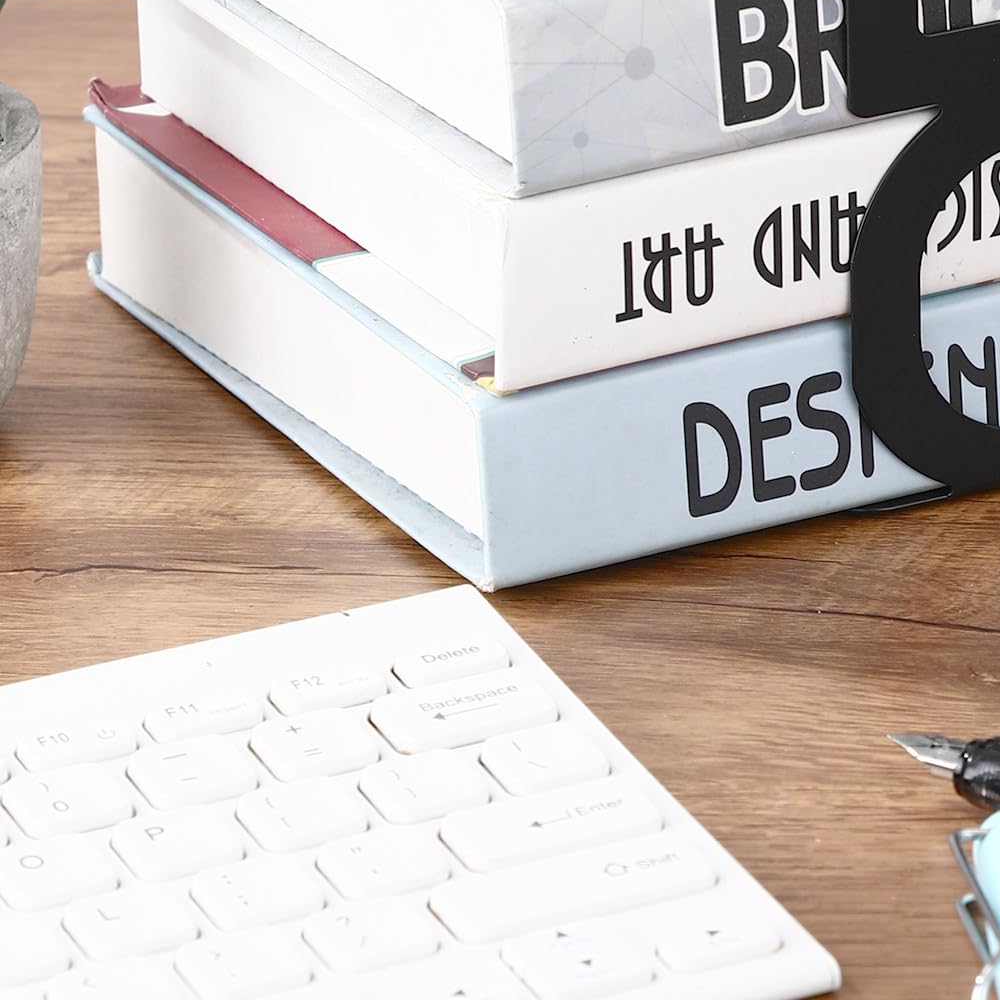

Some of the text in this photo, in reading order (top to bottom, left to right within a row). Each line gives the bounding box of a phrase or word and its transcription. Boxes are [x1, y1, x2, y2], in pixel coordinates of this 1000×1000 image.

[752, 190, 866, 289] AND
[615, 222, 724, 323] ART
[682, 335, 998, 517] DESIN
[421, 642, 481, 666] Delete
[290, 674, 325, 691] F12
[418, 682, 519, 715] Backspace
[164, 703, 200, 719] F11
[36, 731, 71, 748] F10
[575, 797, 625, 819] Enter
[144, 826, 166, 842] P
[636, 851, 682, 871] Shift
